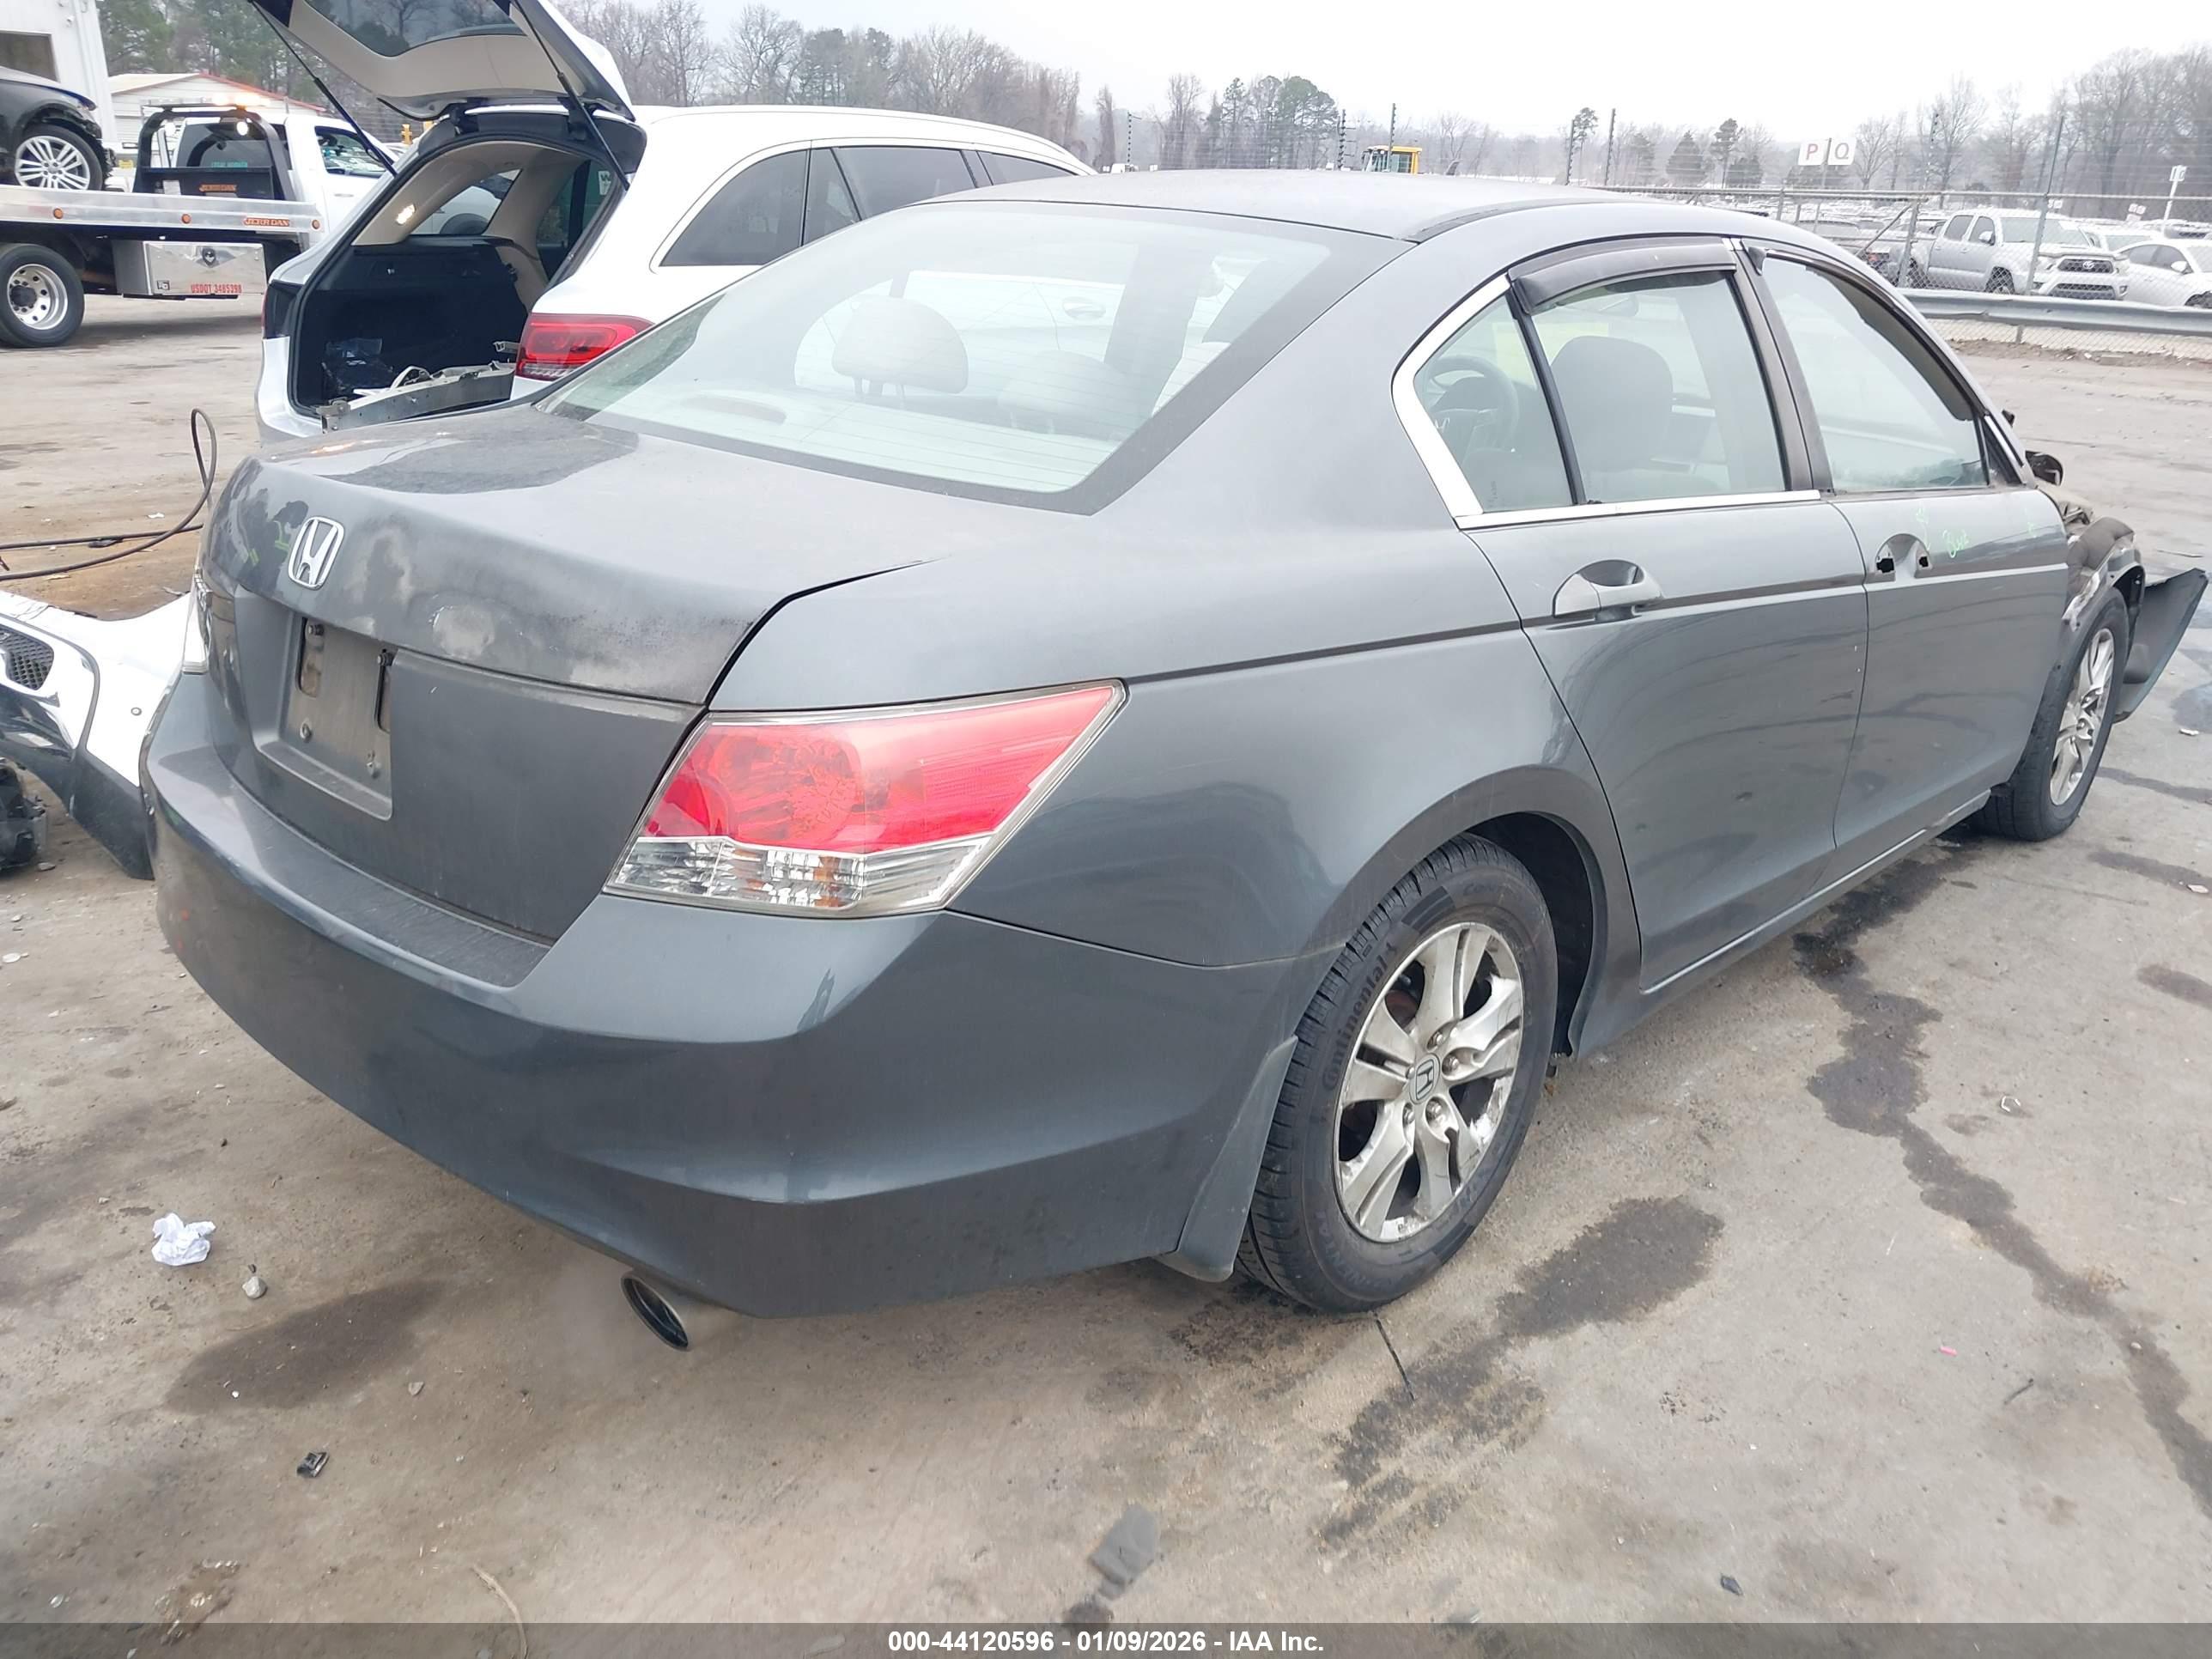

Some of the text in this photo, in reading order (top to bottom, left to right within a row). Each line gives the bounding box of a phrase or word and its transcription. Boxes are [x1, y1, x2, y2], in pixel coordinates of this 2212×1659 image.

[1806, 143, 1819, 161] P
[1834, 143, 1850, 160] Q
[191, 284, 212, 294] USDOT
